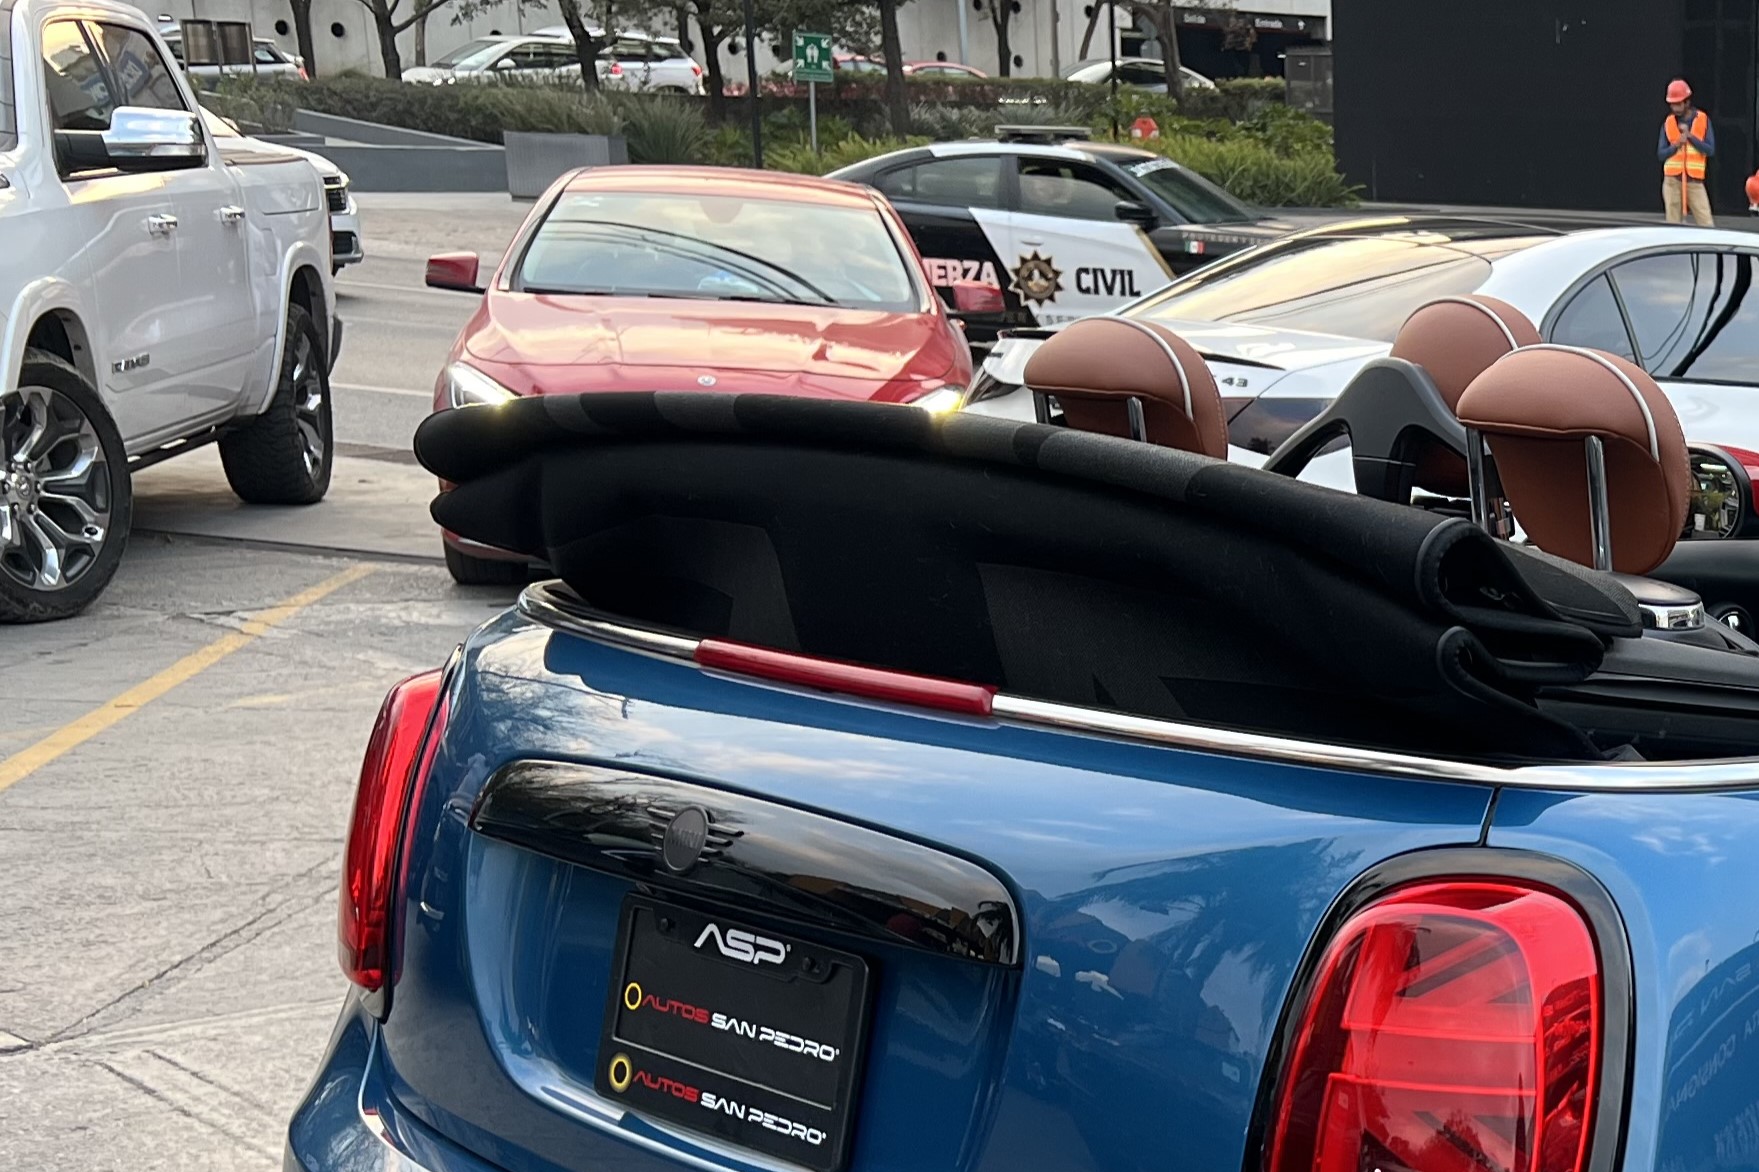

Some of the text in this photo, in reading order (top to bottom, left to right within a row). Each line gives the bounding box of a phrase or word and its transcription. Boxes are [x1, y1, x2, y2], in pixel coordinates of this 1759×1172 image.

[1075, 266, 1141, 297] CIVIL
[642, 994, 836, 1062] AUTOS SAN PEDRO
[633, 1070, 824, 1145] AUTOS SAN PEDRO
